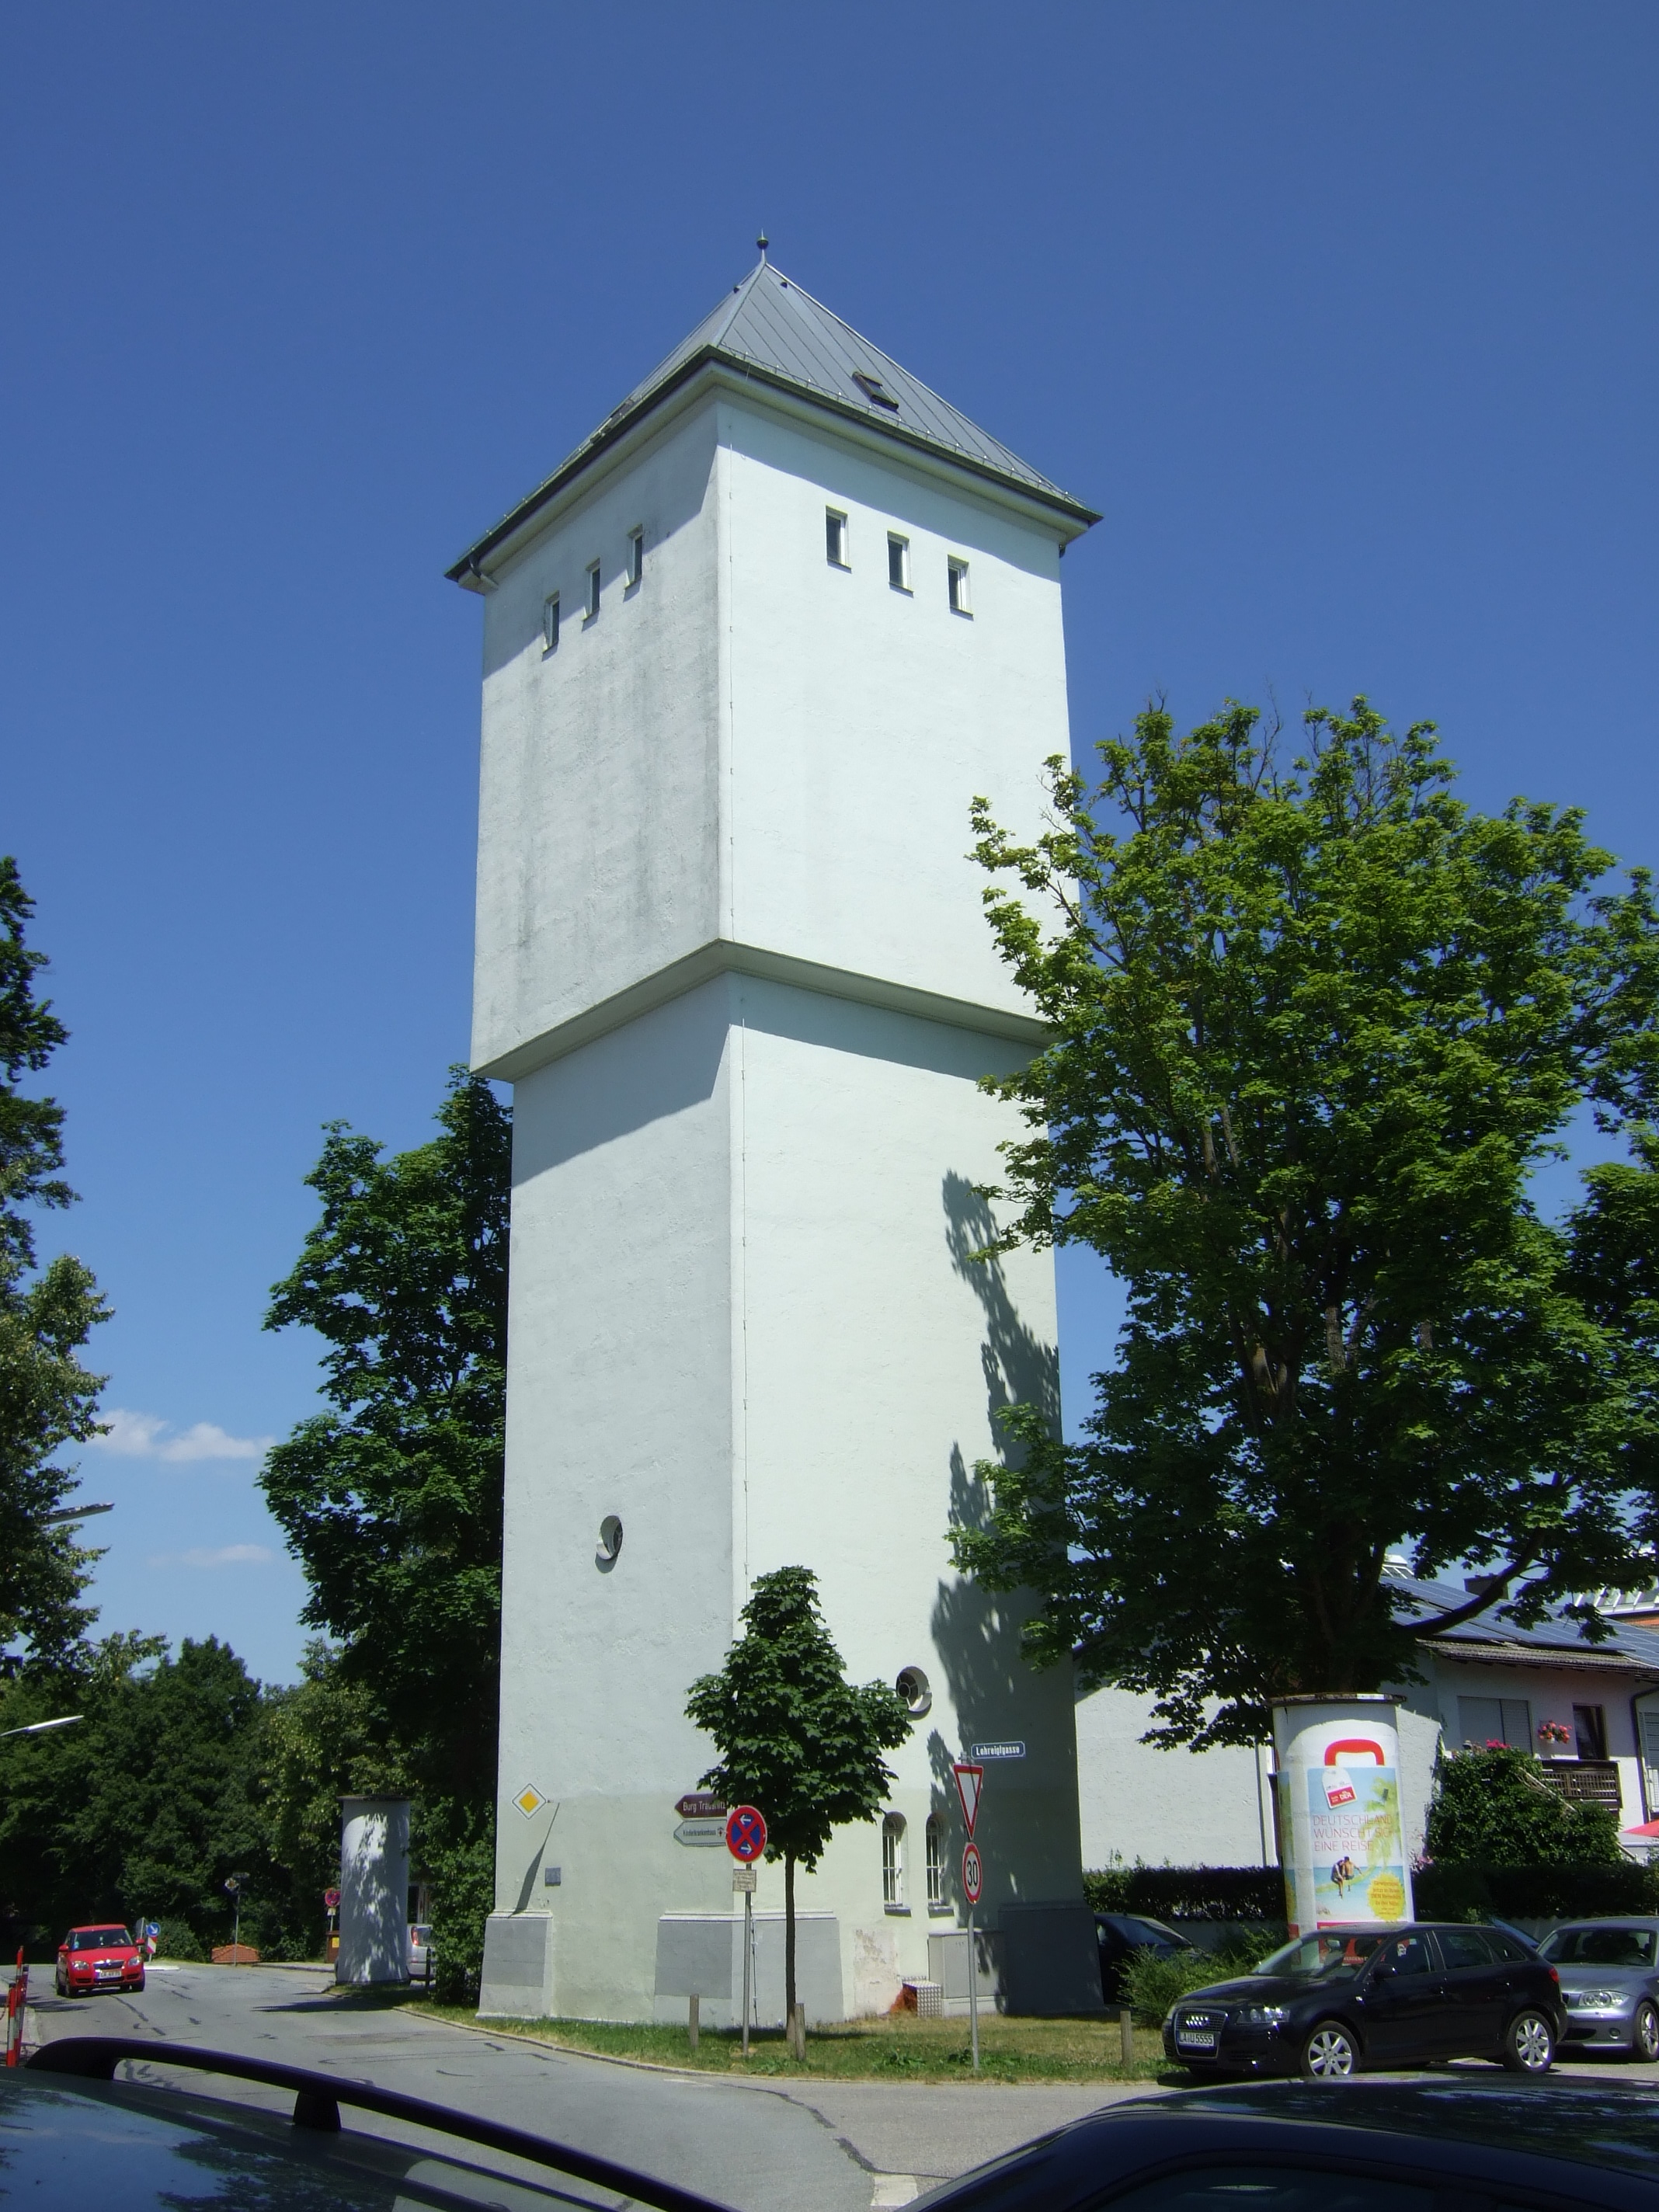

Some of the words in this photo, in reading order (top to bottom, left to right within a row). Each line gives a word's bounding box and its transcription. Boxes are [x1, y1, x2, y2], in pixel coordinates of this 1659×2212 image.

[683, 1801, 697, 1813] Burg
[1313, 1814, 1392, 1826] DEUTSCHLAND
[1314, 1840, 1338, 1852] EINE
[1342, 1840, 1373, 1852] REISE
[967, 1859, 978, 1886] 30
